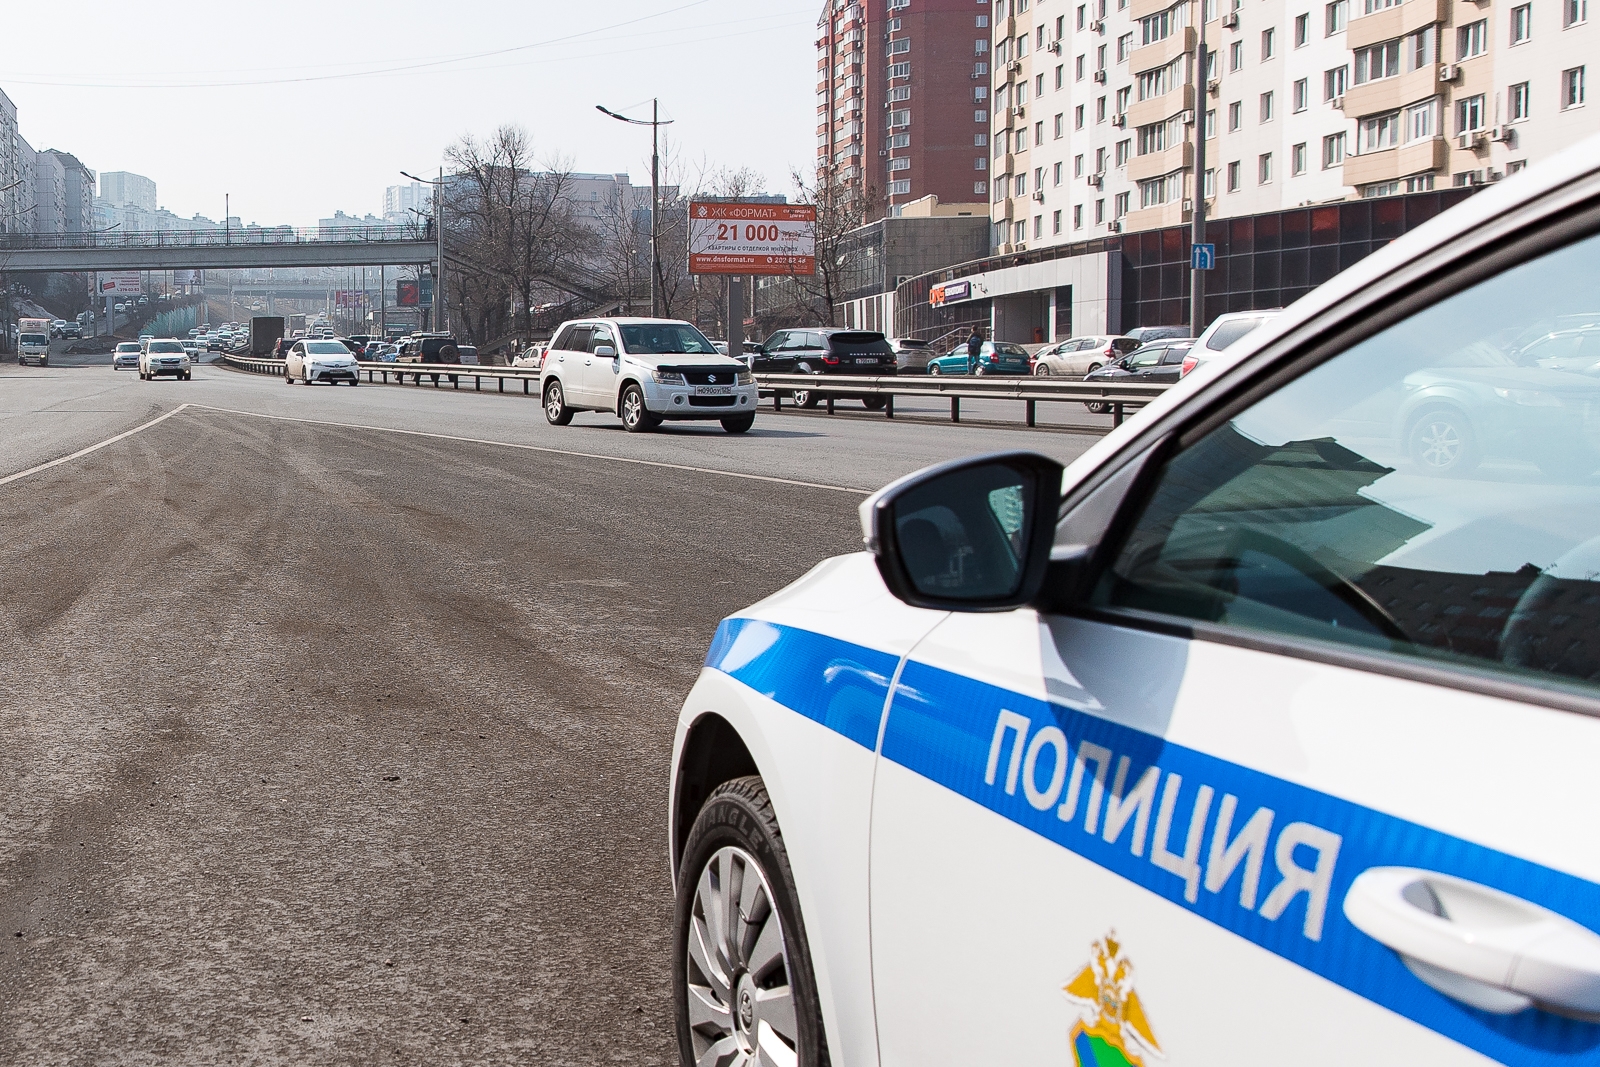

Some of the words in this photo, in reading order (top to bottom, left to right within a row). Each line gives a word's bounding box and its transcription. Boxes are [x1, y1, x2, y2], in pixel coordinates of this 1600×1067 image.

[711, 207, 727, 217] ЖК
[717, 224, 738, 241] 21
[745, 224, 779, 241] 000
[984, 708, 1343, 942] ПОЛИЦИЯ
